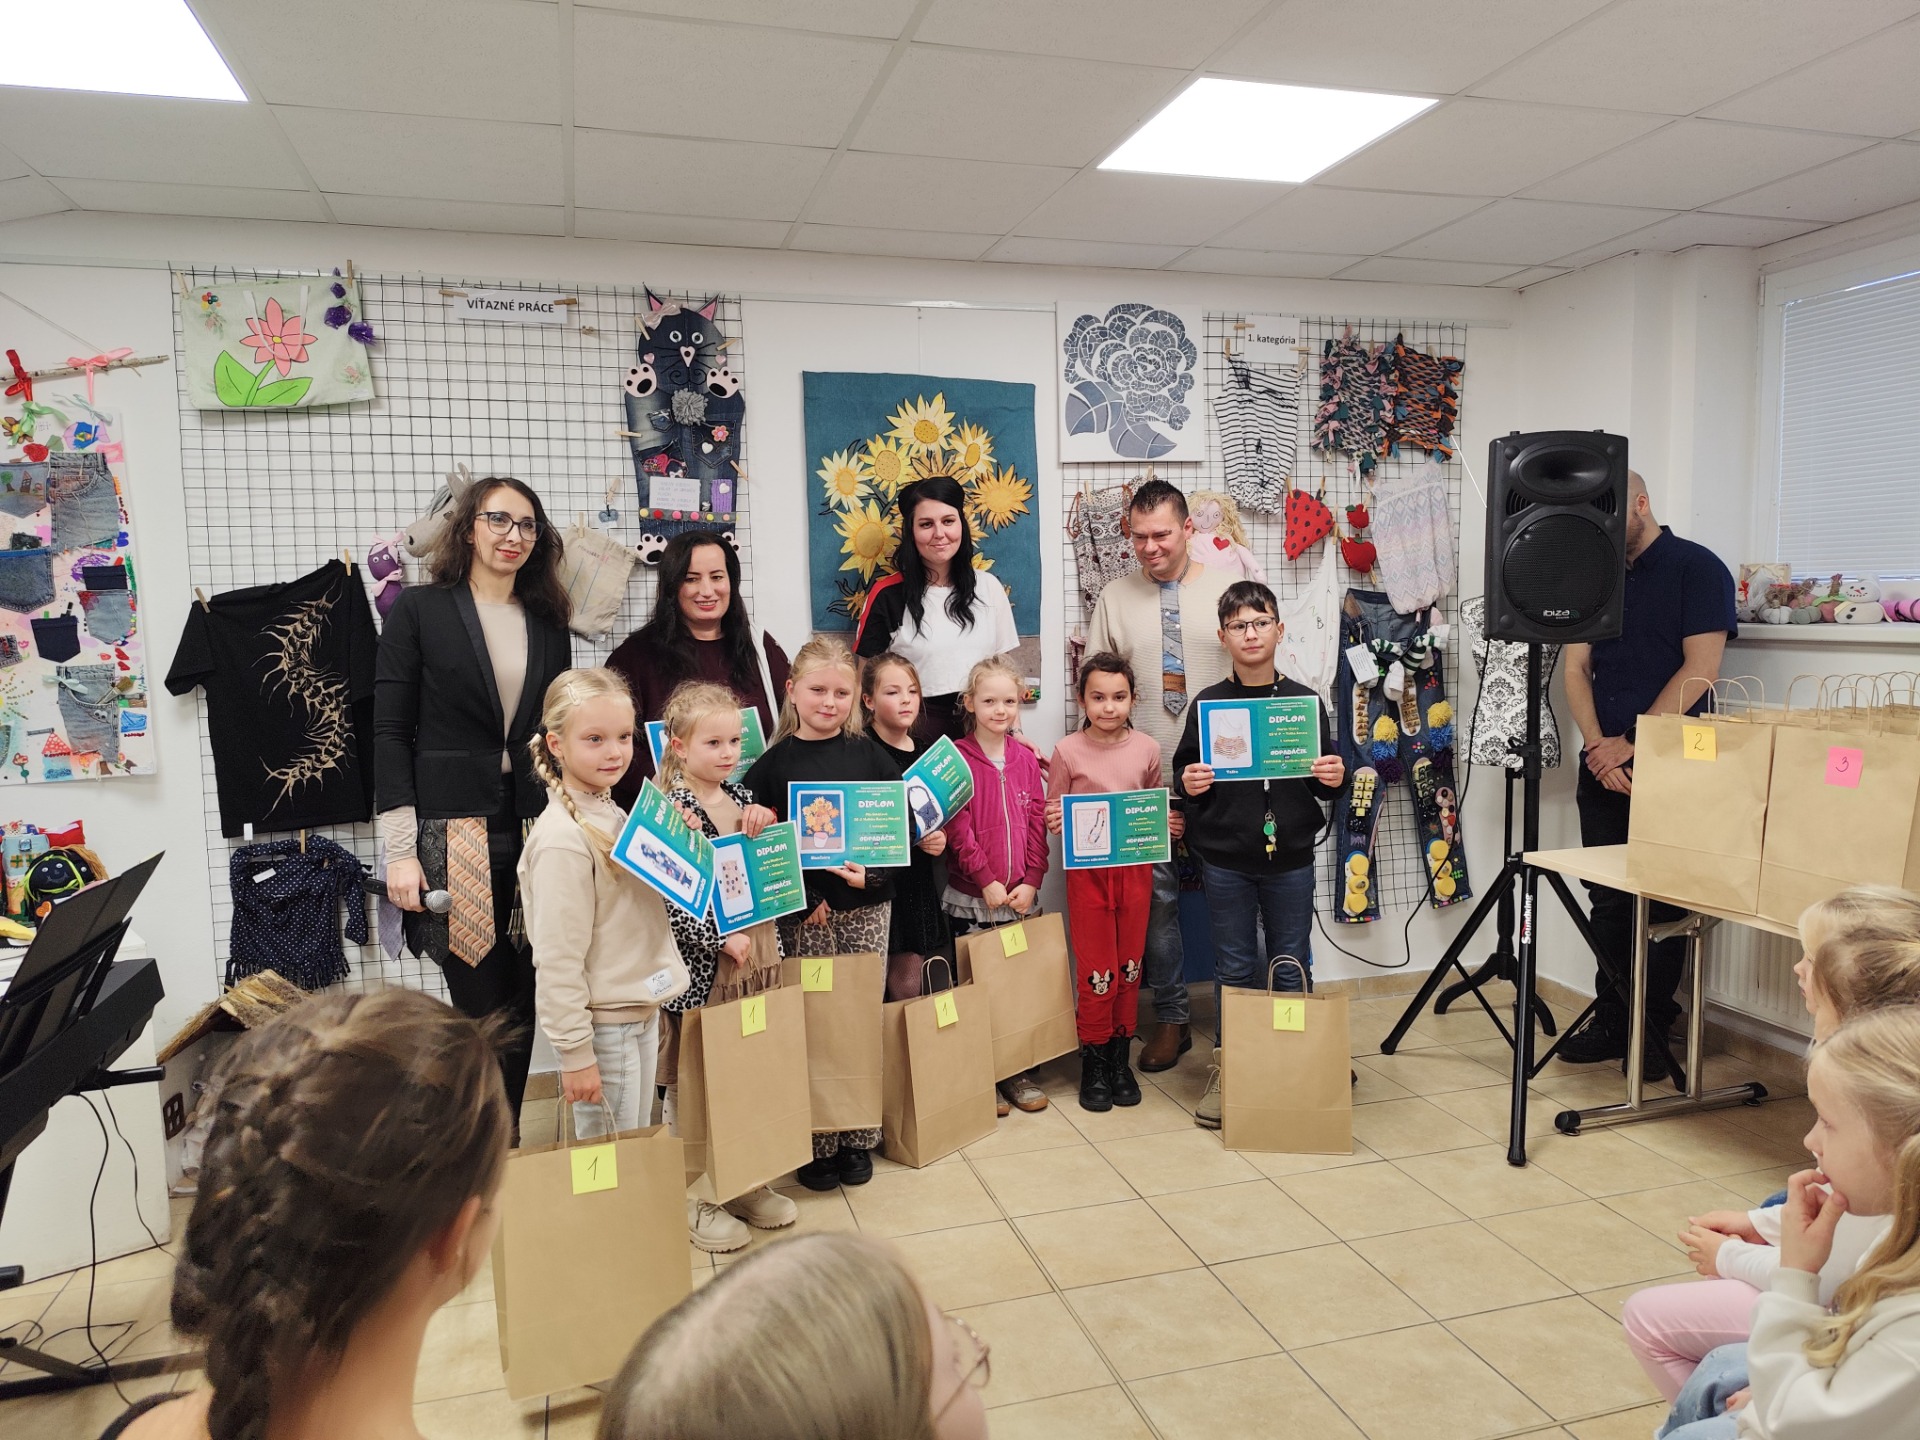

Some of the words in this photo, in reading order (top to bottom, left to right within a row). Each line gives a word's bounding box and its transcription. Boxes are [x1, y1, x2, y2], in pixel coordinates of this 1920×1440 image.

[466, 297, 515, 311] VÍŤAZNÉ
[518, 300, 555, 313] PRÁCE
[1248, 333, 1255, 342] 1.
[1256, 333, 1296, 346] kategória
[1543, 608, 1570, 617] ibiza
[1268, 714, 1306, 724] DIPLOM
[1693, 732, 1705, 751] 2
[1835, 756, 1849, 773] 3
[858, 800, 895, 808] DIPLOM
[1125, 805, 1158, 815] DIPLOM
[756, 843, 788, 857] DIPLOM
[1010, 932, 1017, 946] 1
[811, 965, 822, 984] 1
[749, 1004, 756, 1024] 1
[942, 1001, 948, 1017] 1
[1284, 1006, 1292, 1023] 1
[587, 1156, 598, 1181] 1
